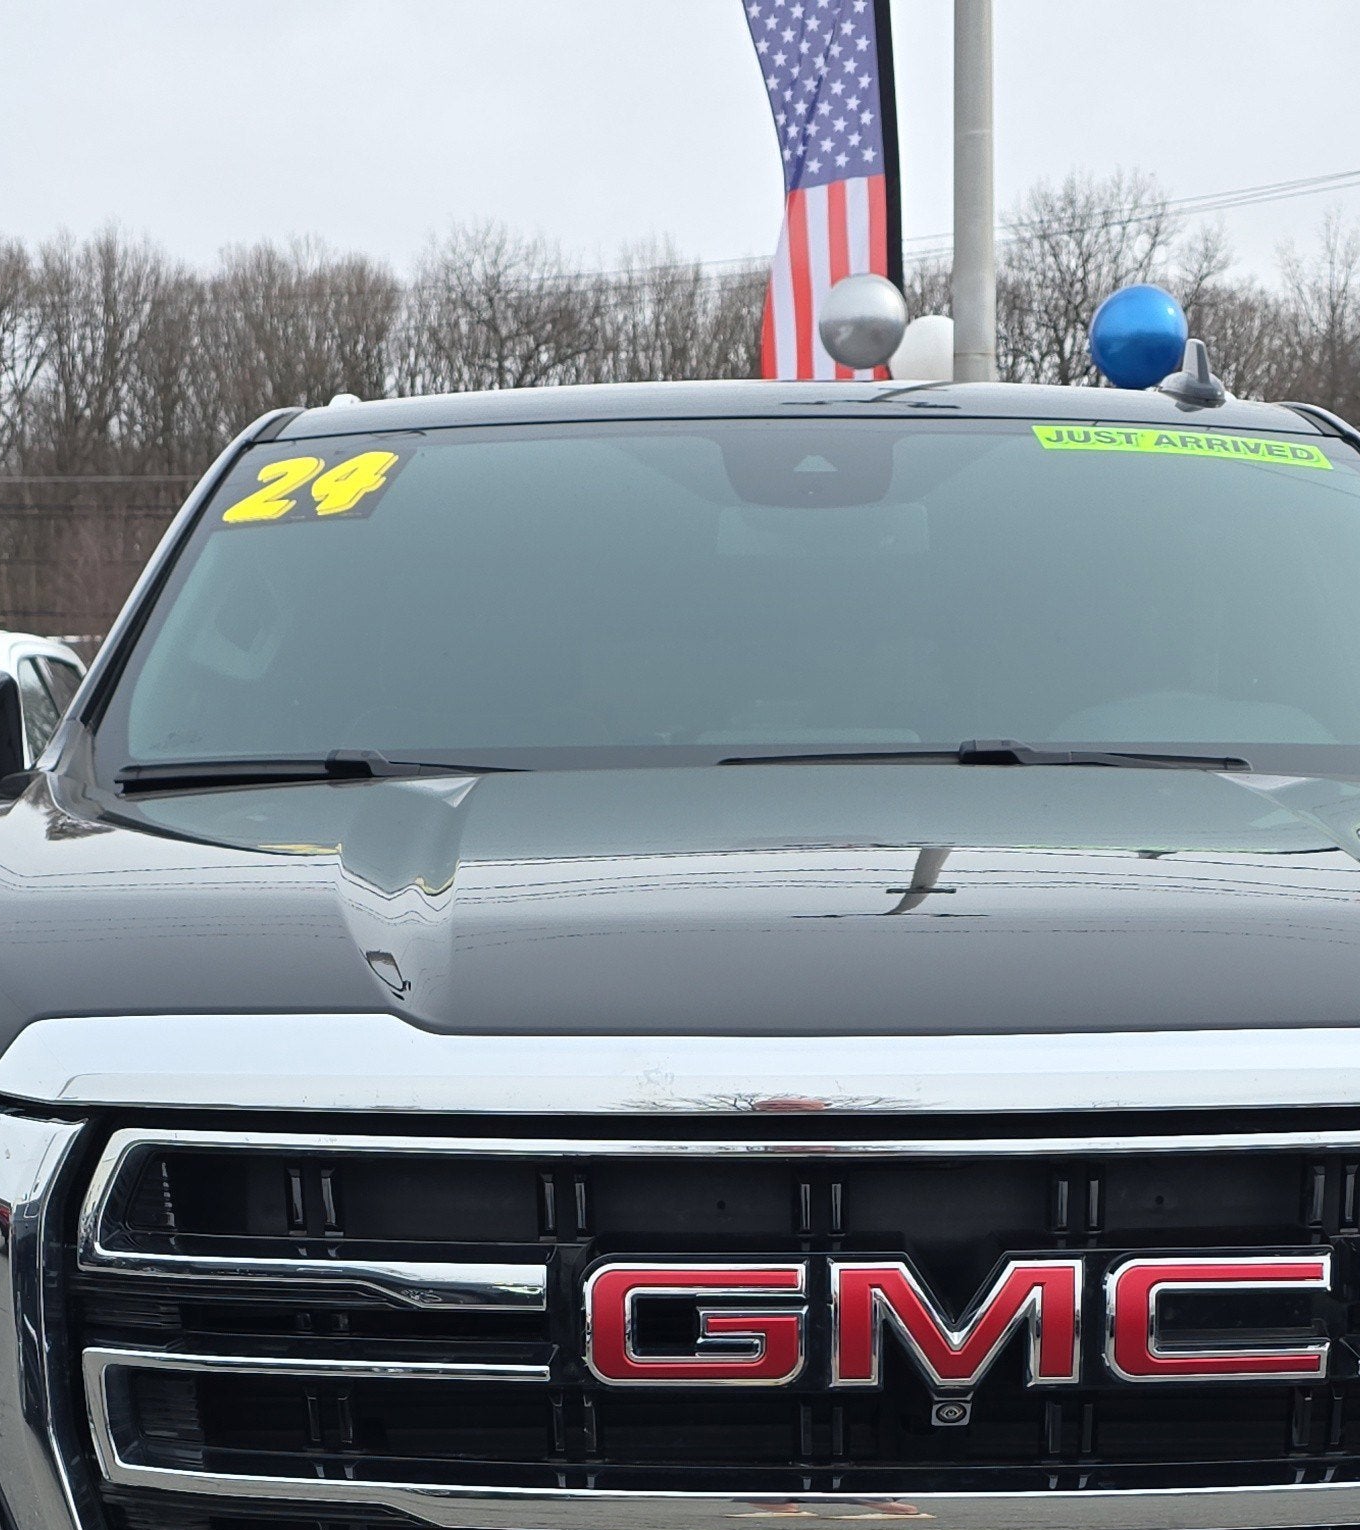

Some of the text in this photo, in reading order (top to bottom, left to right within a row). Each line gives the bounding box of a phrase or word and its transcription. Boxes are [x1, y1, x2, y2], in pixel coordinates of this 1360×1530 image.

[1045, 430, 1319, 461] JUST ARRIVED
[222, 451, 399, 523] 24
[585, 1258, 1332, 1385] GMC
